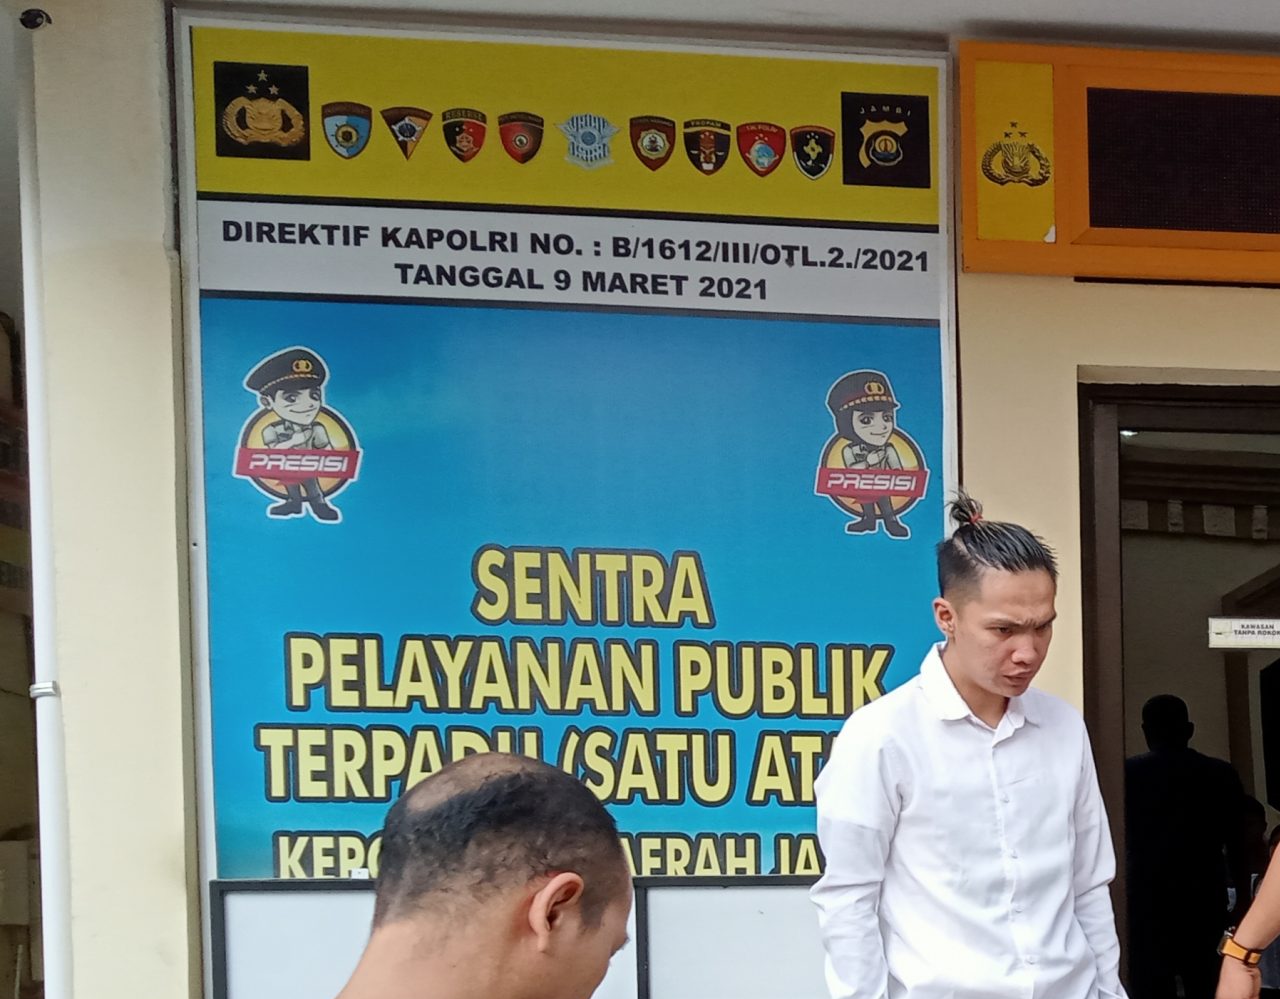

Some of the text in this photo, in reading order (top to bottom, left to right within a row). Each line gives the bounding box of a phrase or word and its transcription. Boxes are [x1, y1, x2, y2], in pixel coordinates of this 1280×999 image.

[222, 220, 370, 246] DIREKTIF
[381, 226, 518, 253] KAPOLRI
[530, 233, 583, 255] NO.
[612, 236, 929, 272] B/1612/III/OTL.2./2021
[394, 262, 767, 300] TANGGAL 9 MARET 2021
[249, 453, 349, 472] PRESISI
[827, 473, 917, 491] PRESISI
[475, 548, 712, 626] SENTRA
[287, 635, 892, 717] PELAYANAN PUBLIK
[750, 735, 840, 802] AT
